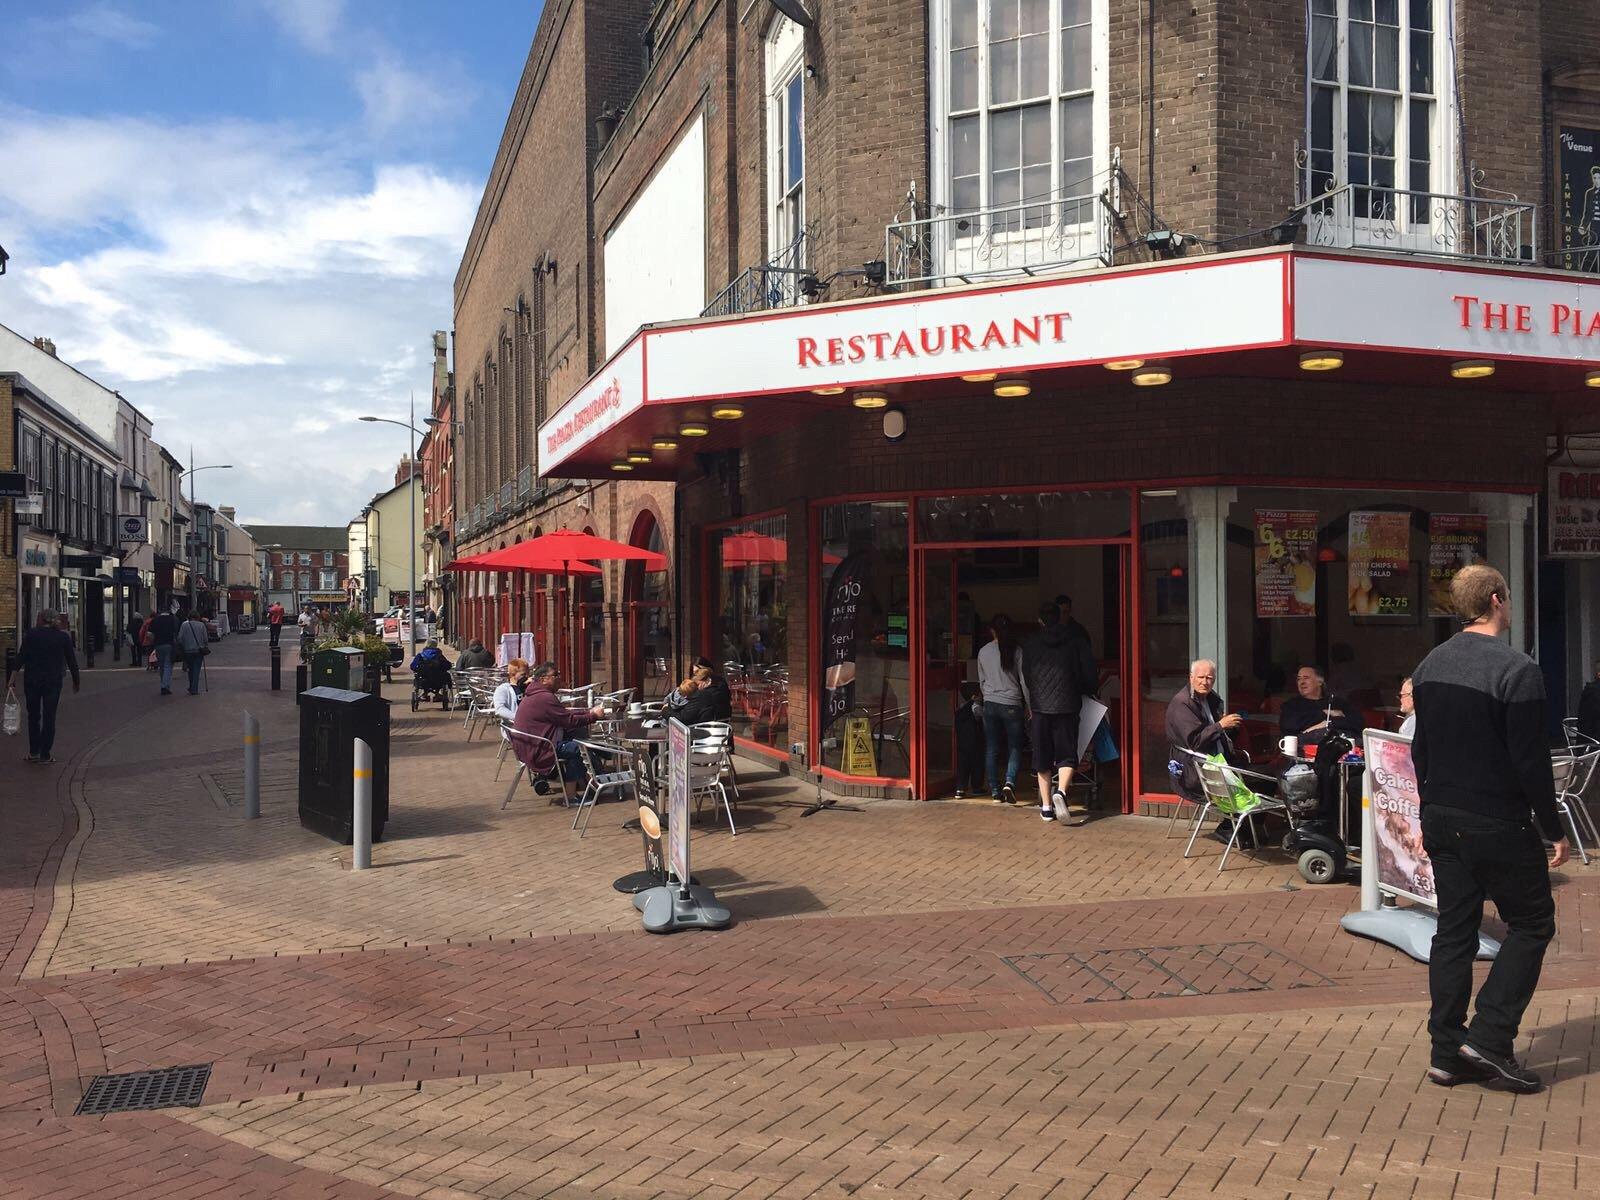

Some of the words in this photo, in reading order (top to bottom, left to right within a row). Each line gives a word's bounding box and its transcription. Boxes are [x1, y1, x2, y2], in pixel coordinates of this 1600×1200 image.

[1567, 141, 1593, 153] Venue
[1452, 295, 1533, 334] THE
[796, 311, 1072, 368] RESTAURANT
[1285, 529, 1316, 540] £2.50
[1378, 597, 1408, 607] £2.75
[1374, 767, 1416, 794] Cake
